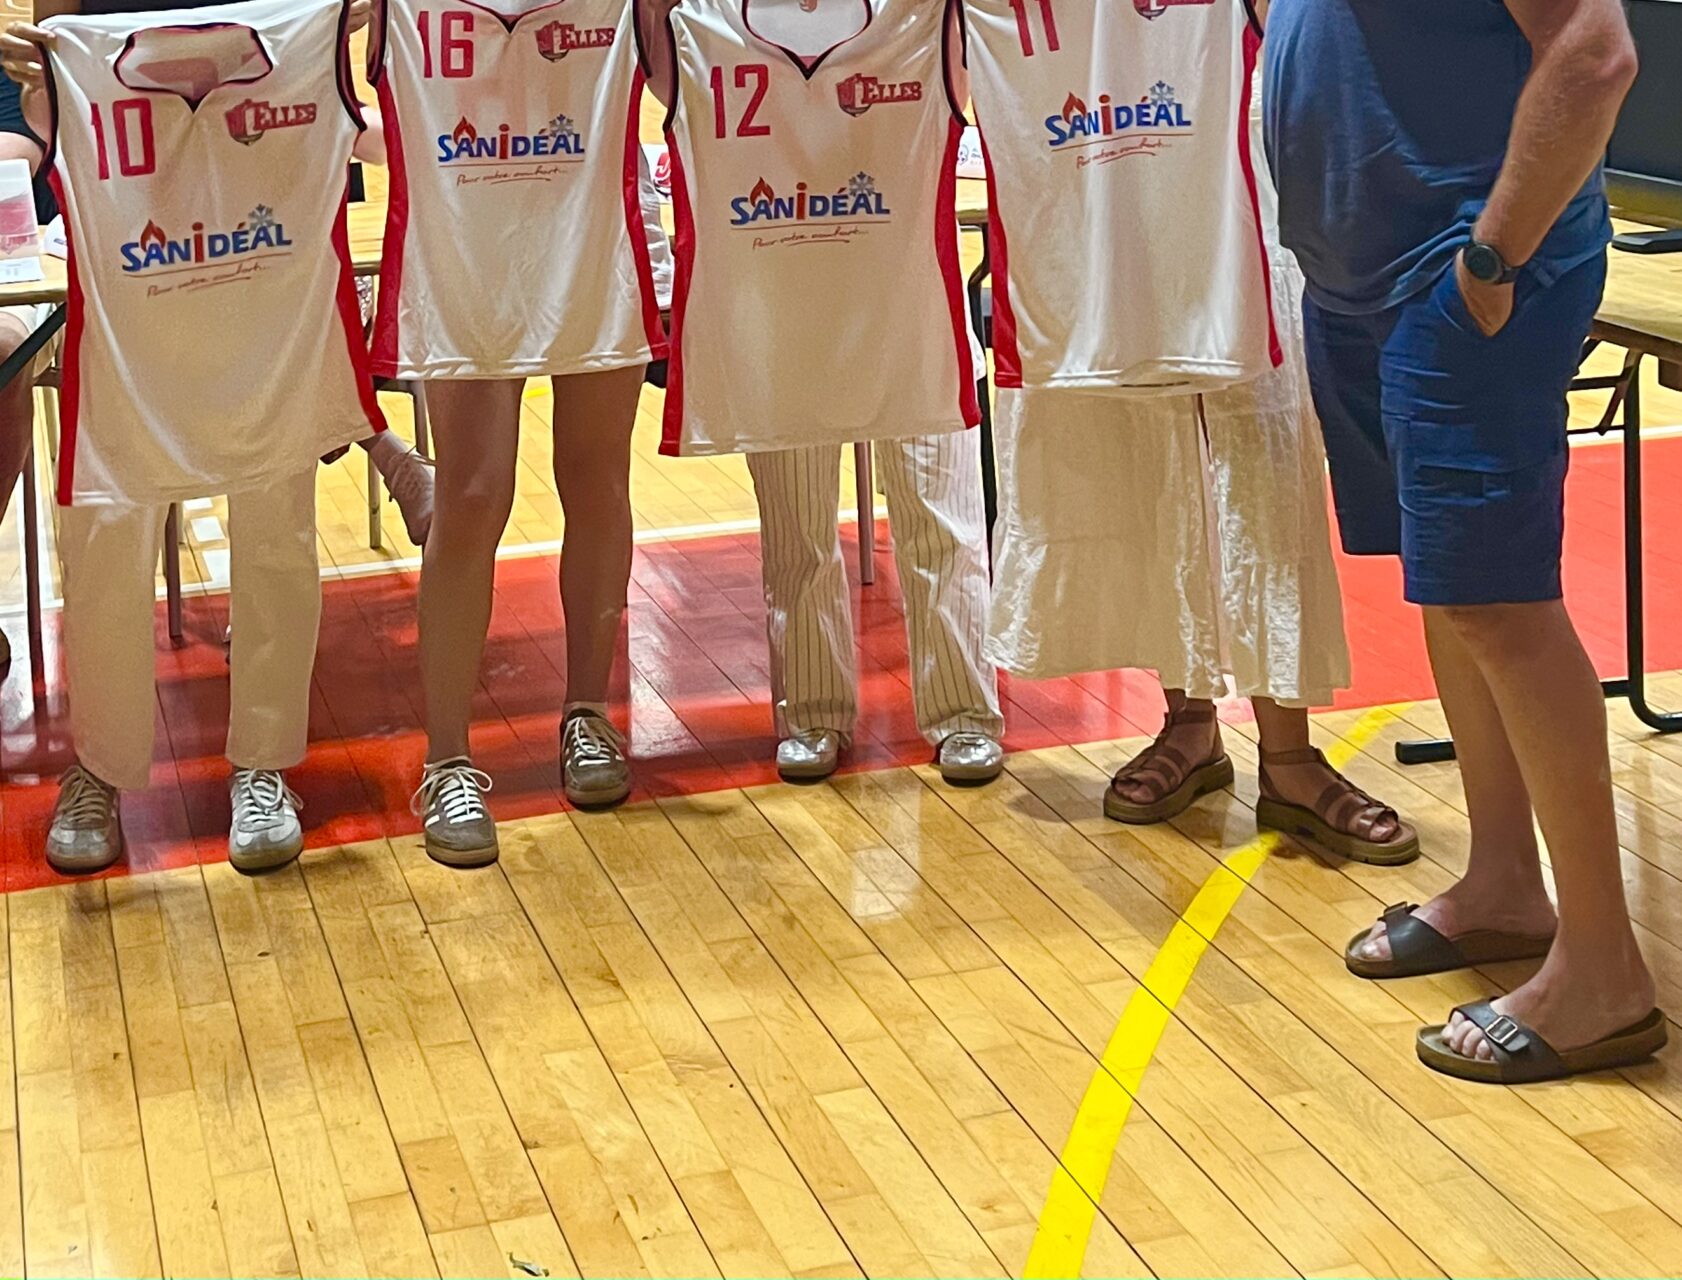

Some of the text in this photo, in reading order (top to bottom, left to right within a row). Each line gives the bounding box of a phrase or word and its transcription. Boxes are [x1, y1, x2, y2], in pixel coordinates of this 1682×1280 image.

[417, 11, 474, 79] 16
[710, 64, 771, 139] 12
[90, 98, 156, 181] 10
